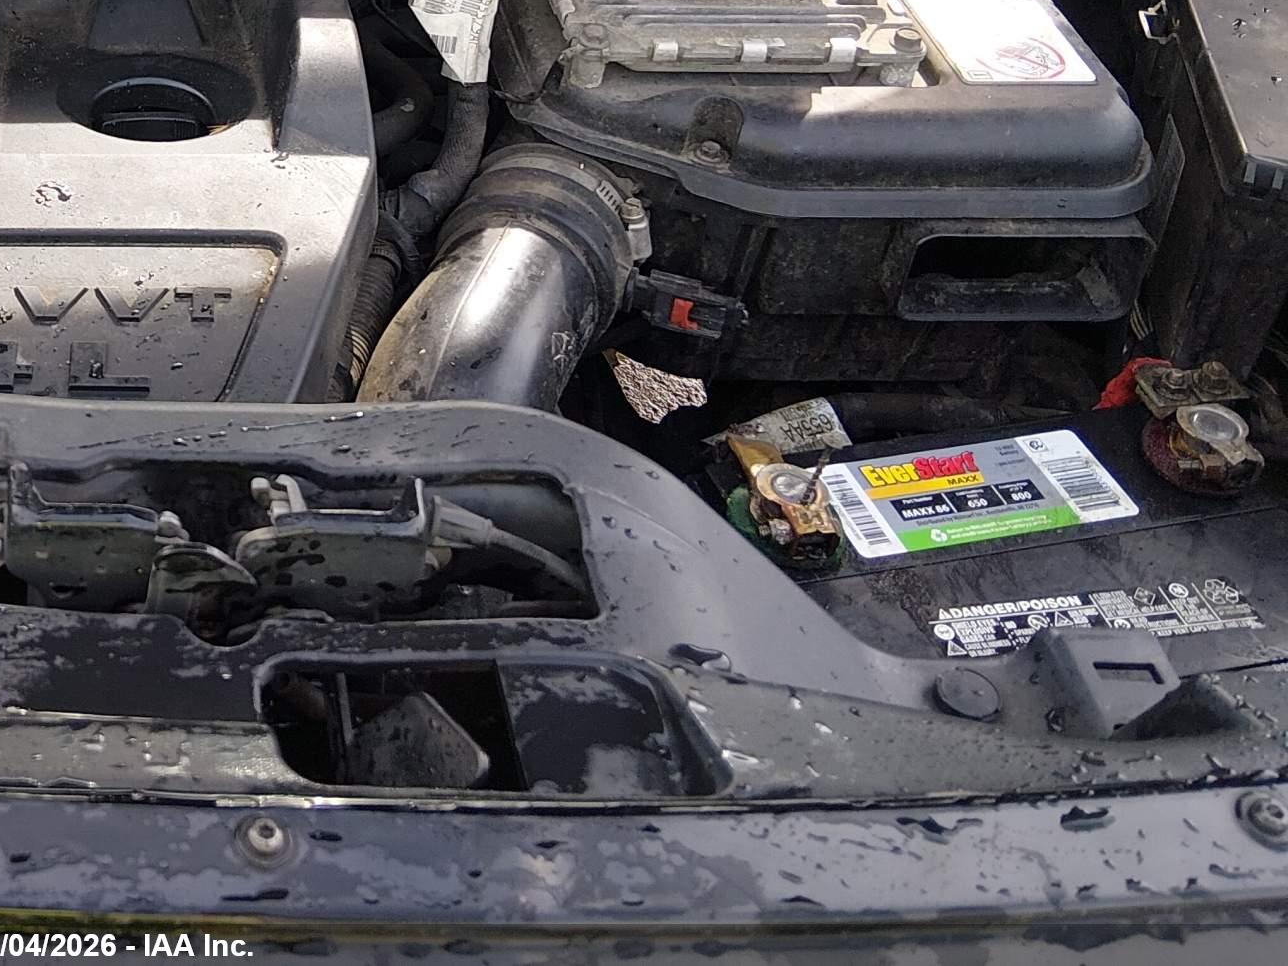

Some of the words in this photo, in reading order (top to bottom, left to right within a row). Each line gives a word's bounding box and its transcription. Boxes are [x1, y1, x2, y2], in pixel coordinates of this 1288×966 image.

[13, 284, 232, 324] VVT
[860, 450, 980, 489] EverStart
[945, 474, 980, 486] MAXX
[967, 498, 989, 509] 650
[1010, 491, 1033, 502] 800
[902, 506, 936, 519] MAXX
[935, 504, 951, 514] 86
[949, 595, 1082, 619] DANGER/POISON
